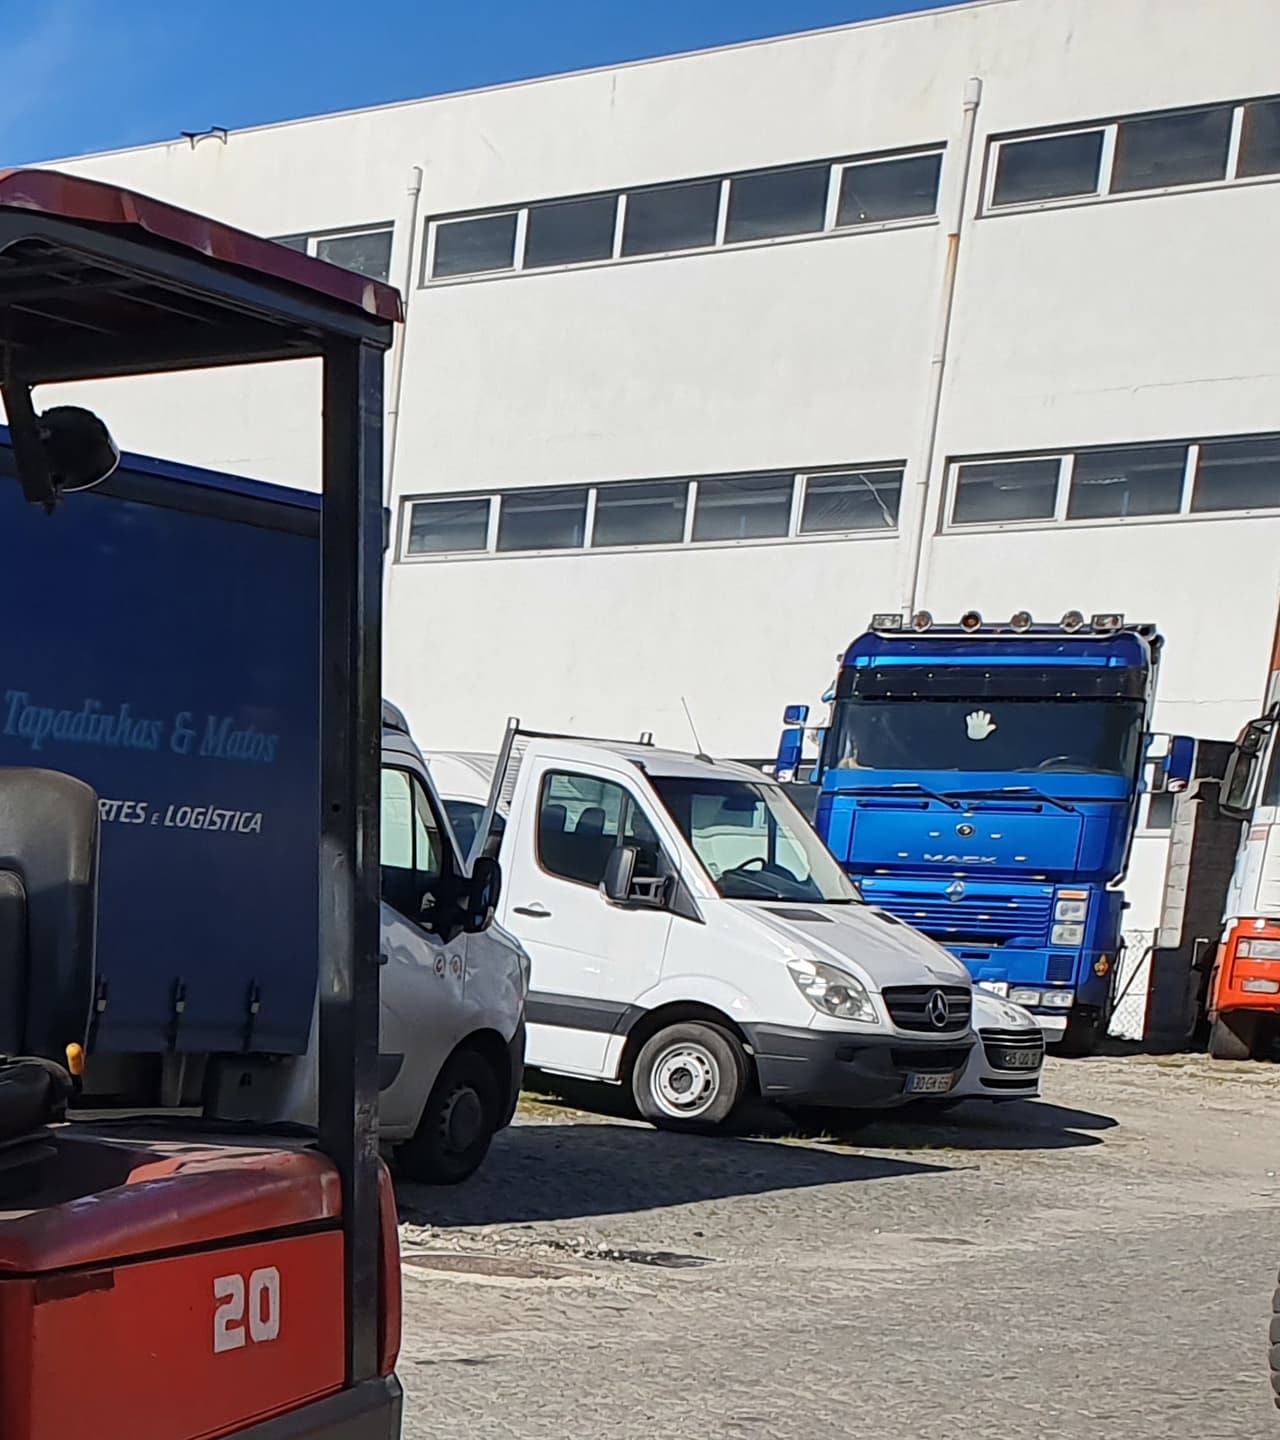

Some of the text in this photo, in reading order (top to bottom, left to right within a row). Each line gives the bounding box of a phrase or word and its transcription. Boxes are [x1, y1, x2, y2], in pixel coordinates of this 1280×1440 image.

[2, 688, 280, 764] Tapadinhas & Matos
[98, 797, 148, 824] RTES
[163, 804, 264, 834] LOGÍSTICA
[923, 853, 998, 864] MACK
[212, 1265, 281, 1353] 20
